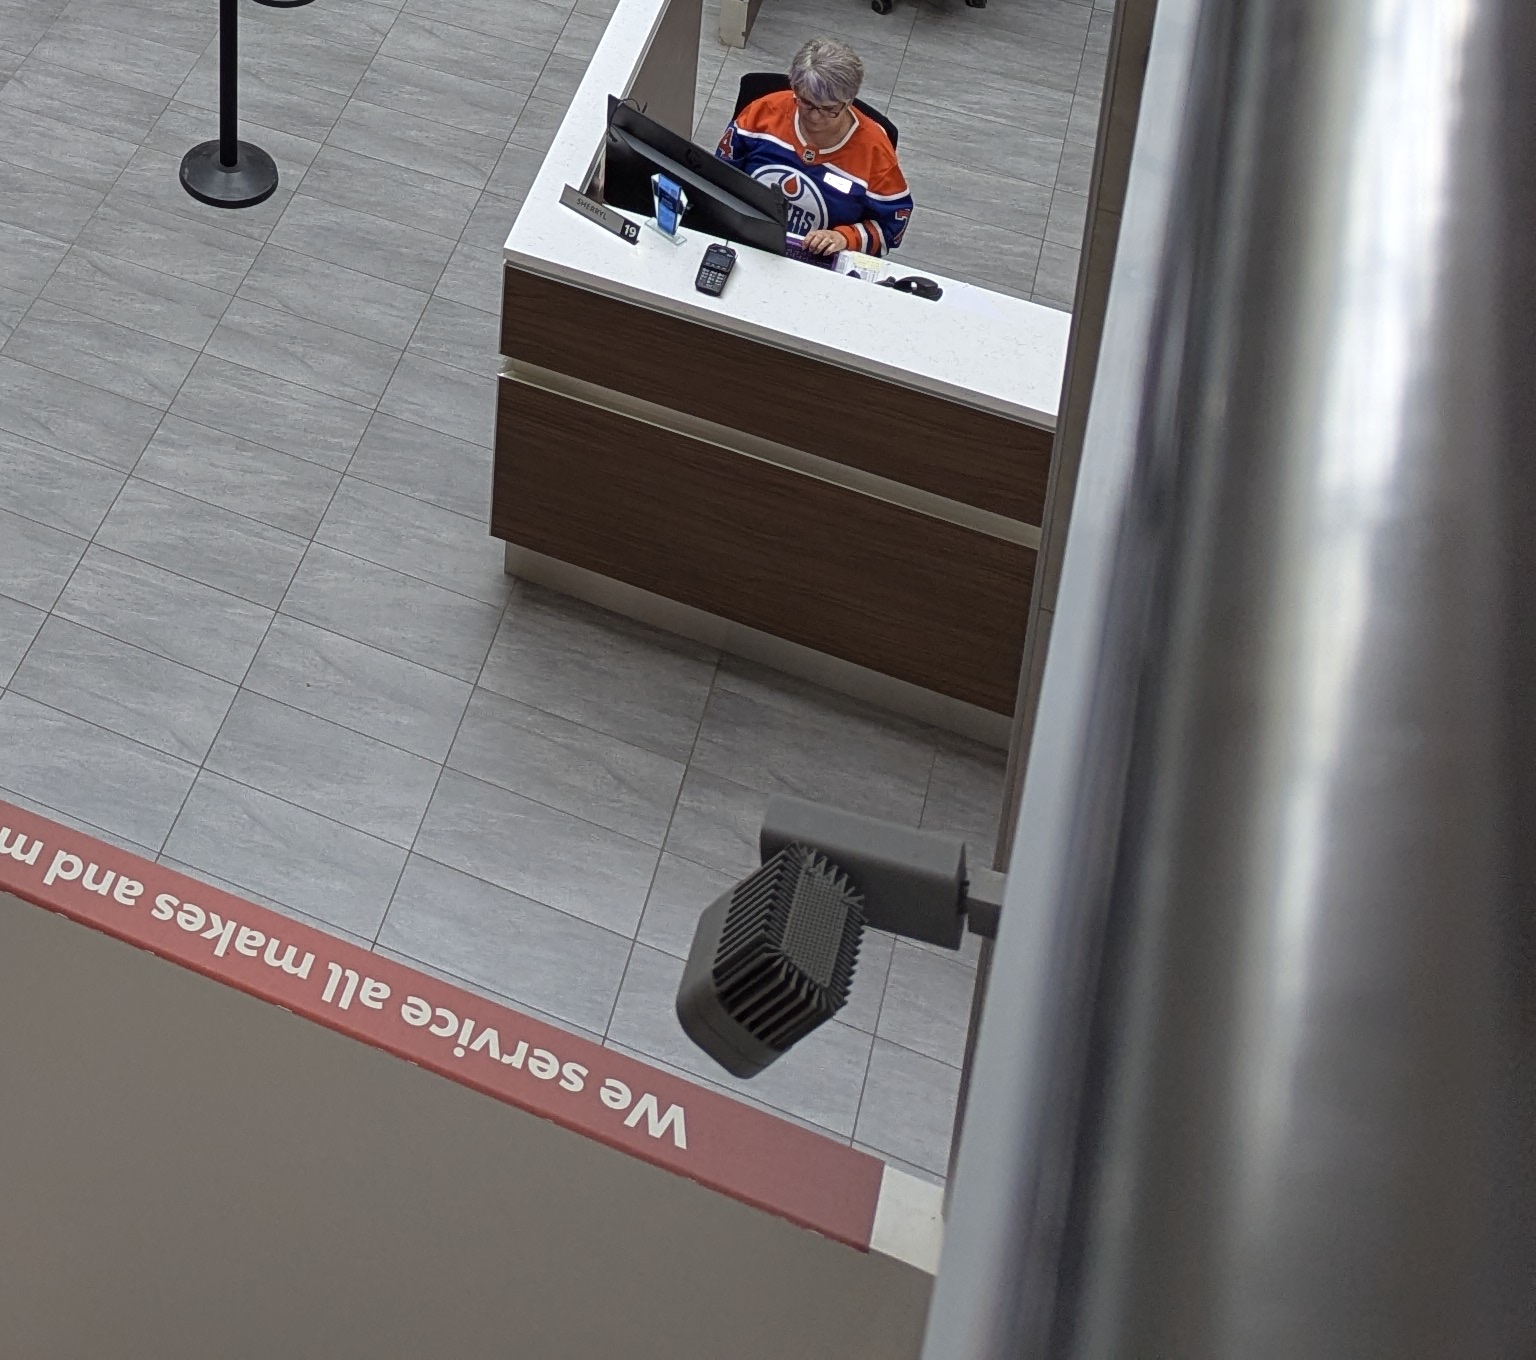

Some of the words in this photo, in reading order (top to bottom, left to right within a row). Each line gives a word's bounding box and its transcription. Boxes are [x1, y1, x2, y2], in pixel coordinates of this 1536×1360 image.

[576, 198, 607, 220] SHERRYL
[624, 224, 636, 238] 19
[43, 849, 144, 906] and
[151, 893, 315, 979] makes
[321, 962, 391, 1010] all
[401, 996, 589, 1092] service
[599, 1078, 687, 1149] We
